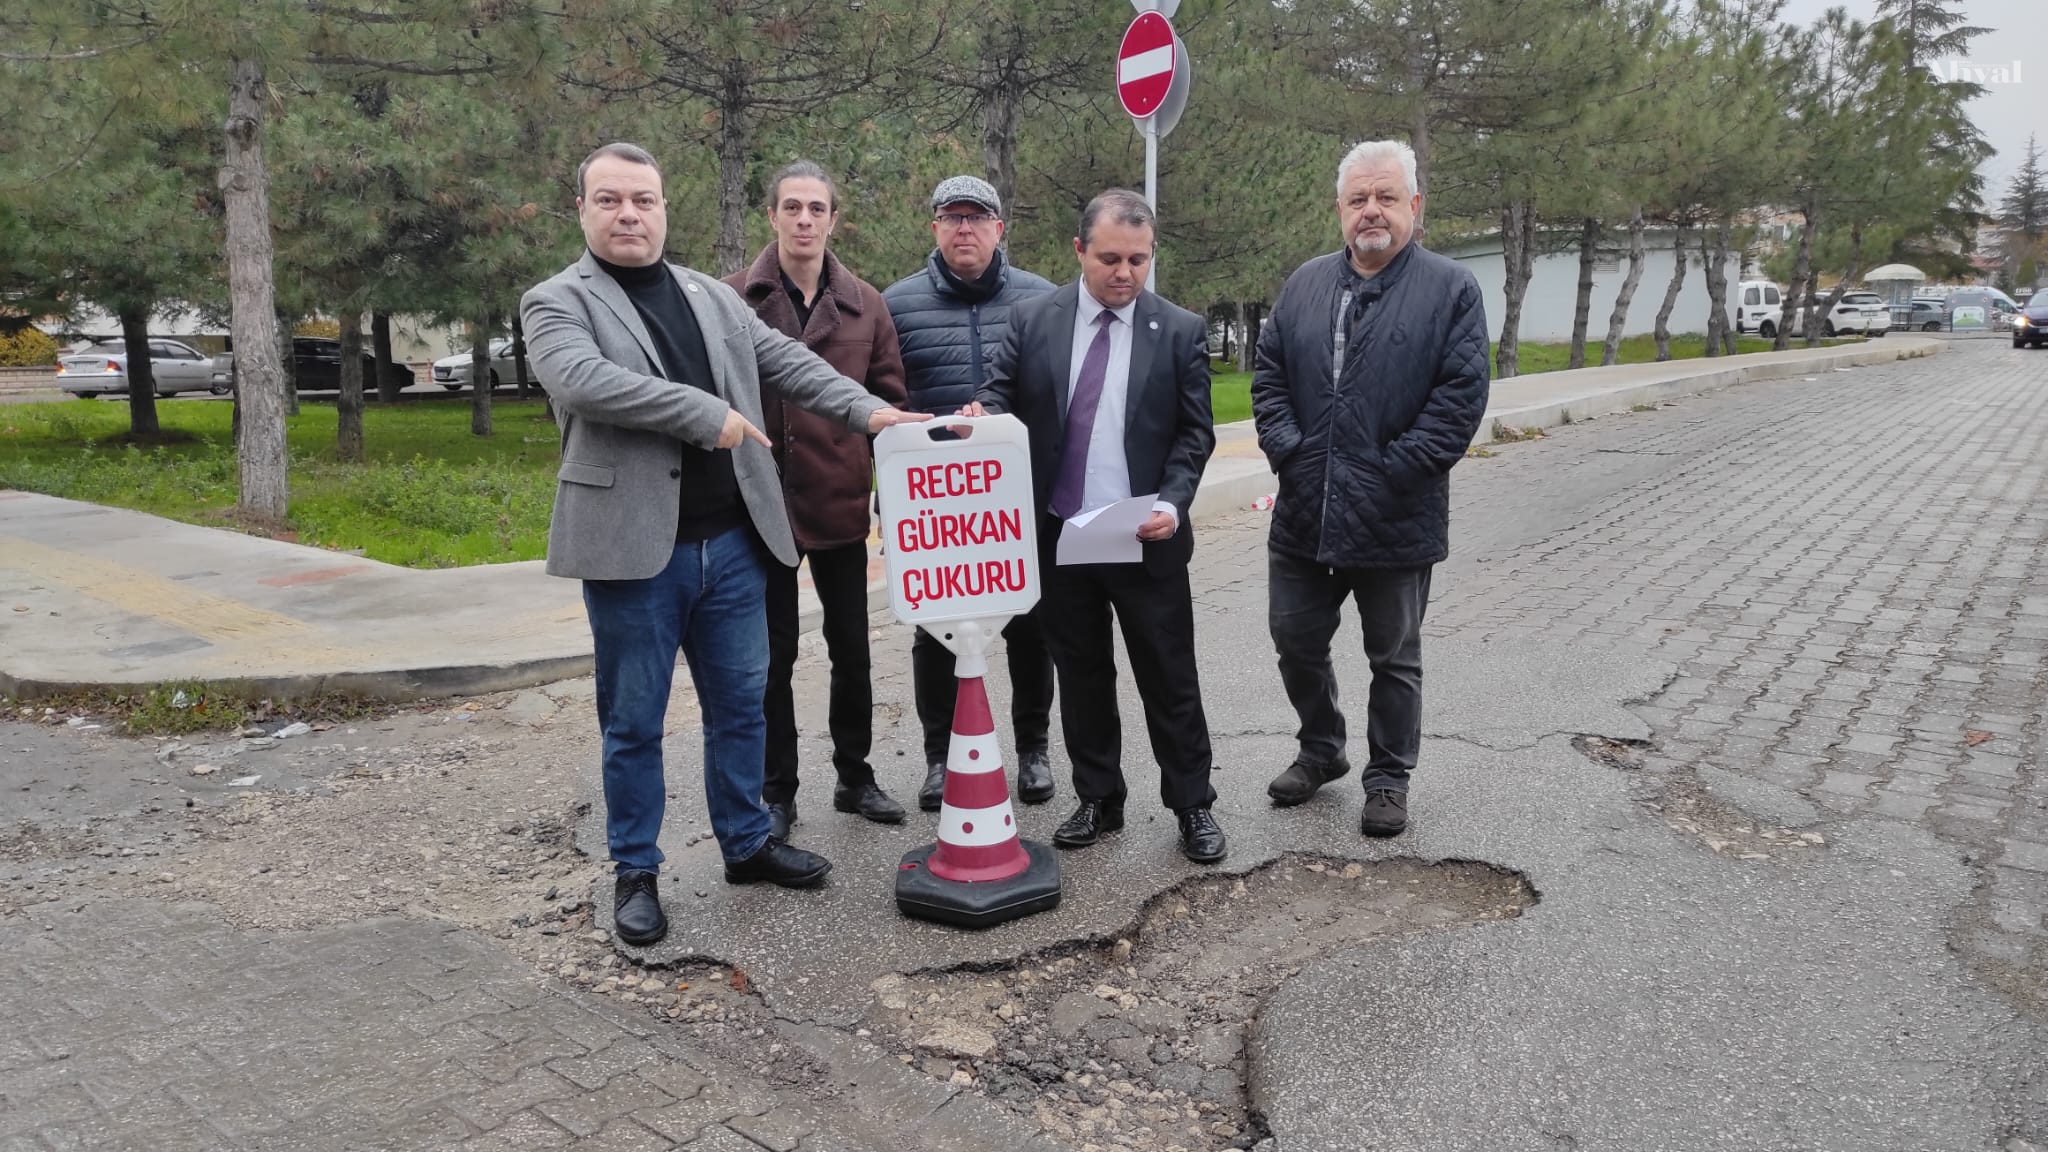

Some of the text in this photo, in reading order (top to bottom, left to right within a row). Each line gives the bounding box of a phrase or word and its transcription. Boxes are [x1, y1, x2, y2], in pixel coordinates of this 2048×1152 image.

[907, 459, 1002, 501] RECEP
[897, 508, 1022, 553] GÜRKAN
[902, 558, 1026, 610] ÇUKURU
